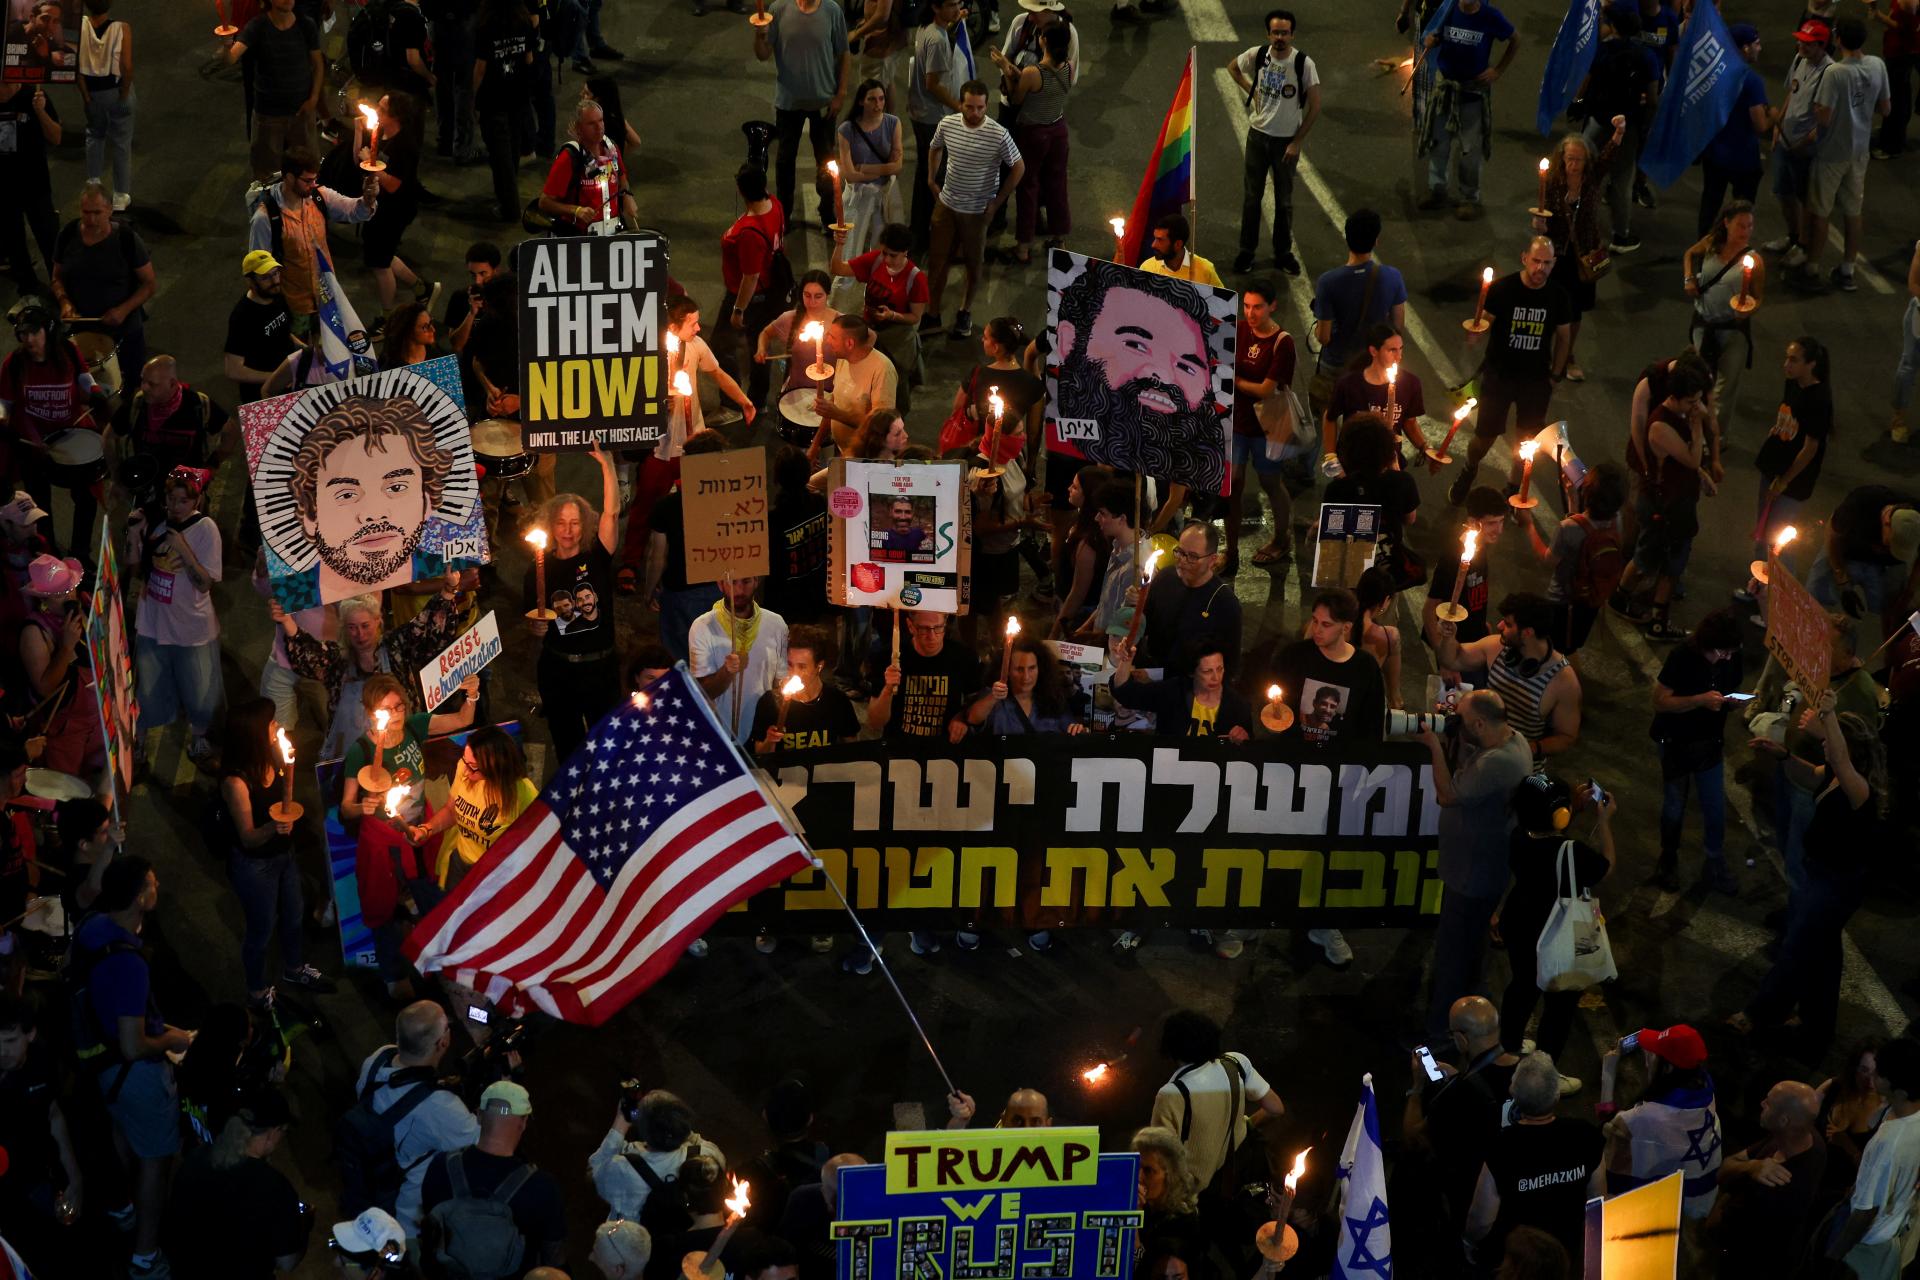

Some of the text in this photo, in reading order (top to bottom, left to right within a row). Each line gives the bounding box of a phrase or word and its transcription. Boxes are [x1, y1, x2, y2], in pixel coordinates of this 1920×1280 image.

[528, 239, 657, 294] ALL OF
[528, 291, 658, 357] THEM
[1512, 306, 1547, 322] למה הם
[1510, 320, 1545, 336] עדיין
[1508, 334, 1542, 351] בעזה?
[528, 356, 659, 422] NOW!
[529, 426, 659, 447] UNTIL THE LAST HOSTAGE!
[1059, 421, 1094, 440] איתן
[698, 475, 762, 495] ולמוות
[734, 496, 765, 516] לא
[716, 519, 764, 537] תהיה
[446, 539, 476, 560] אלון
[440, 627, 481, 677] Resist
[427, 636, 500, 710] dehumanization
[905, 674, 949, 696] הביתה!
[783, 729, 832, 751] SEAL
[750, 757, 1036, 835] ישרא
[1040, 847, 1176, 909] את
[894, 1143, 1091, 1188] TRUMP
[1518, 1164, 1586, 1192] @MEHAZKIM
[940, 1191, 1021, 1221] WE
[830, 1210, 1144, 1280] TRUST
